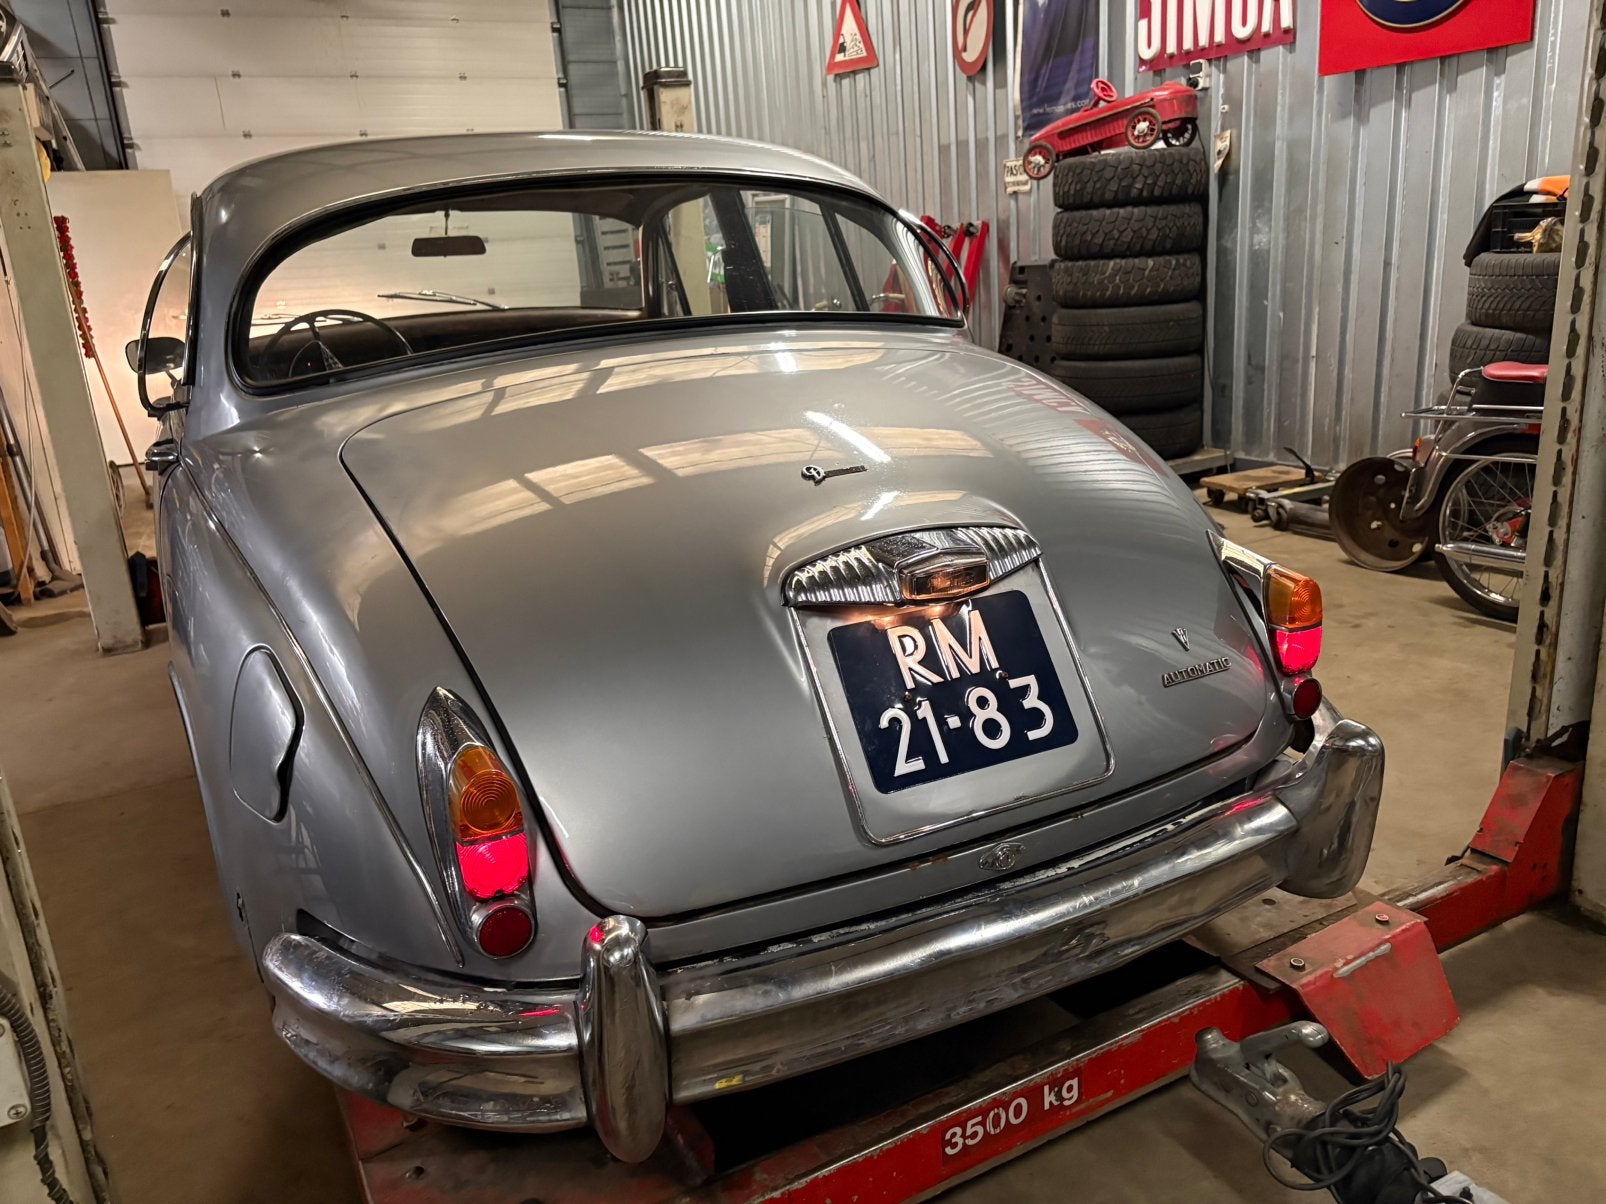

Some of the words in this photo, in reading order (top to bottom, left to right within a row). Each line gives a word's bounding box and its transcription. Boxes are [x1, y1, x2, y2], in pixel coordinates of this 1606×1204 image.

[886, 609, 999, 690] RM
[1162, 657, 1232, 687] AUTOMATIC
[879, 674, 1054, 777] 21-83
[944, 1096, 1029, 1156] 3500
[1043, 1077, 1079, 1111] kg
